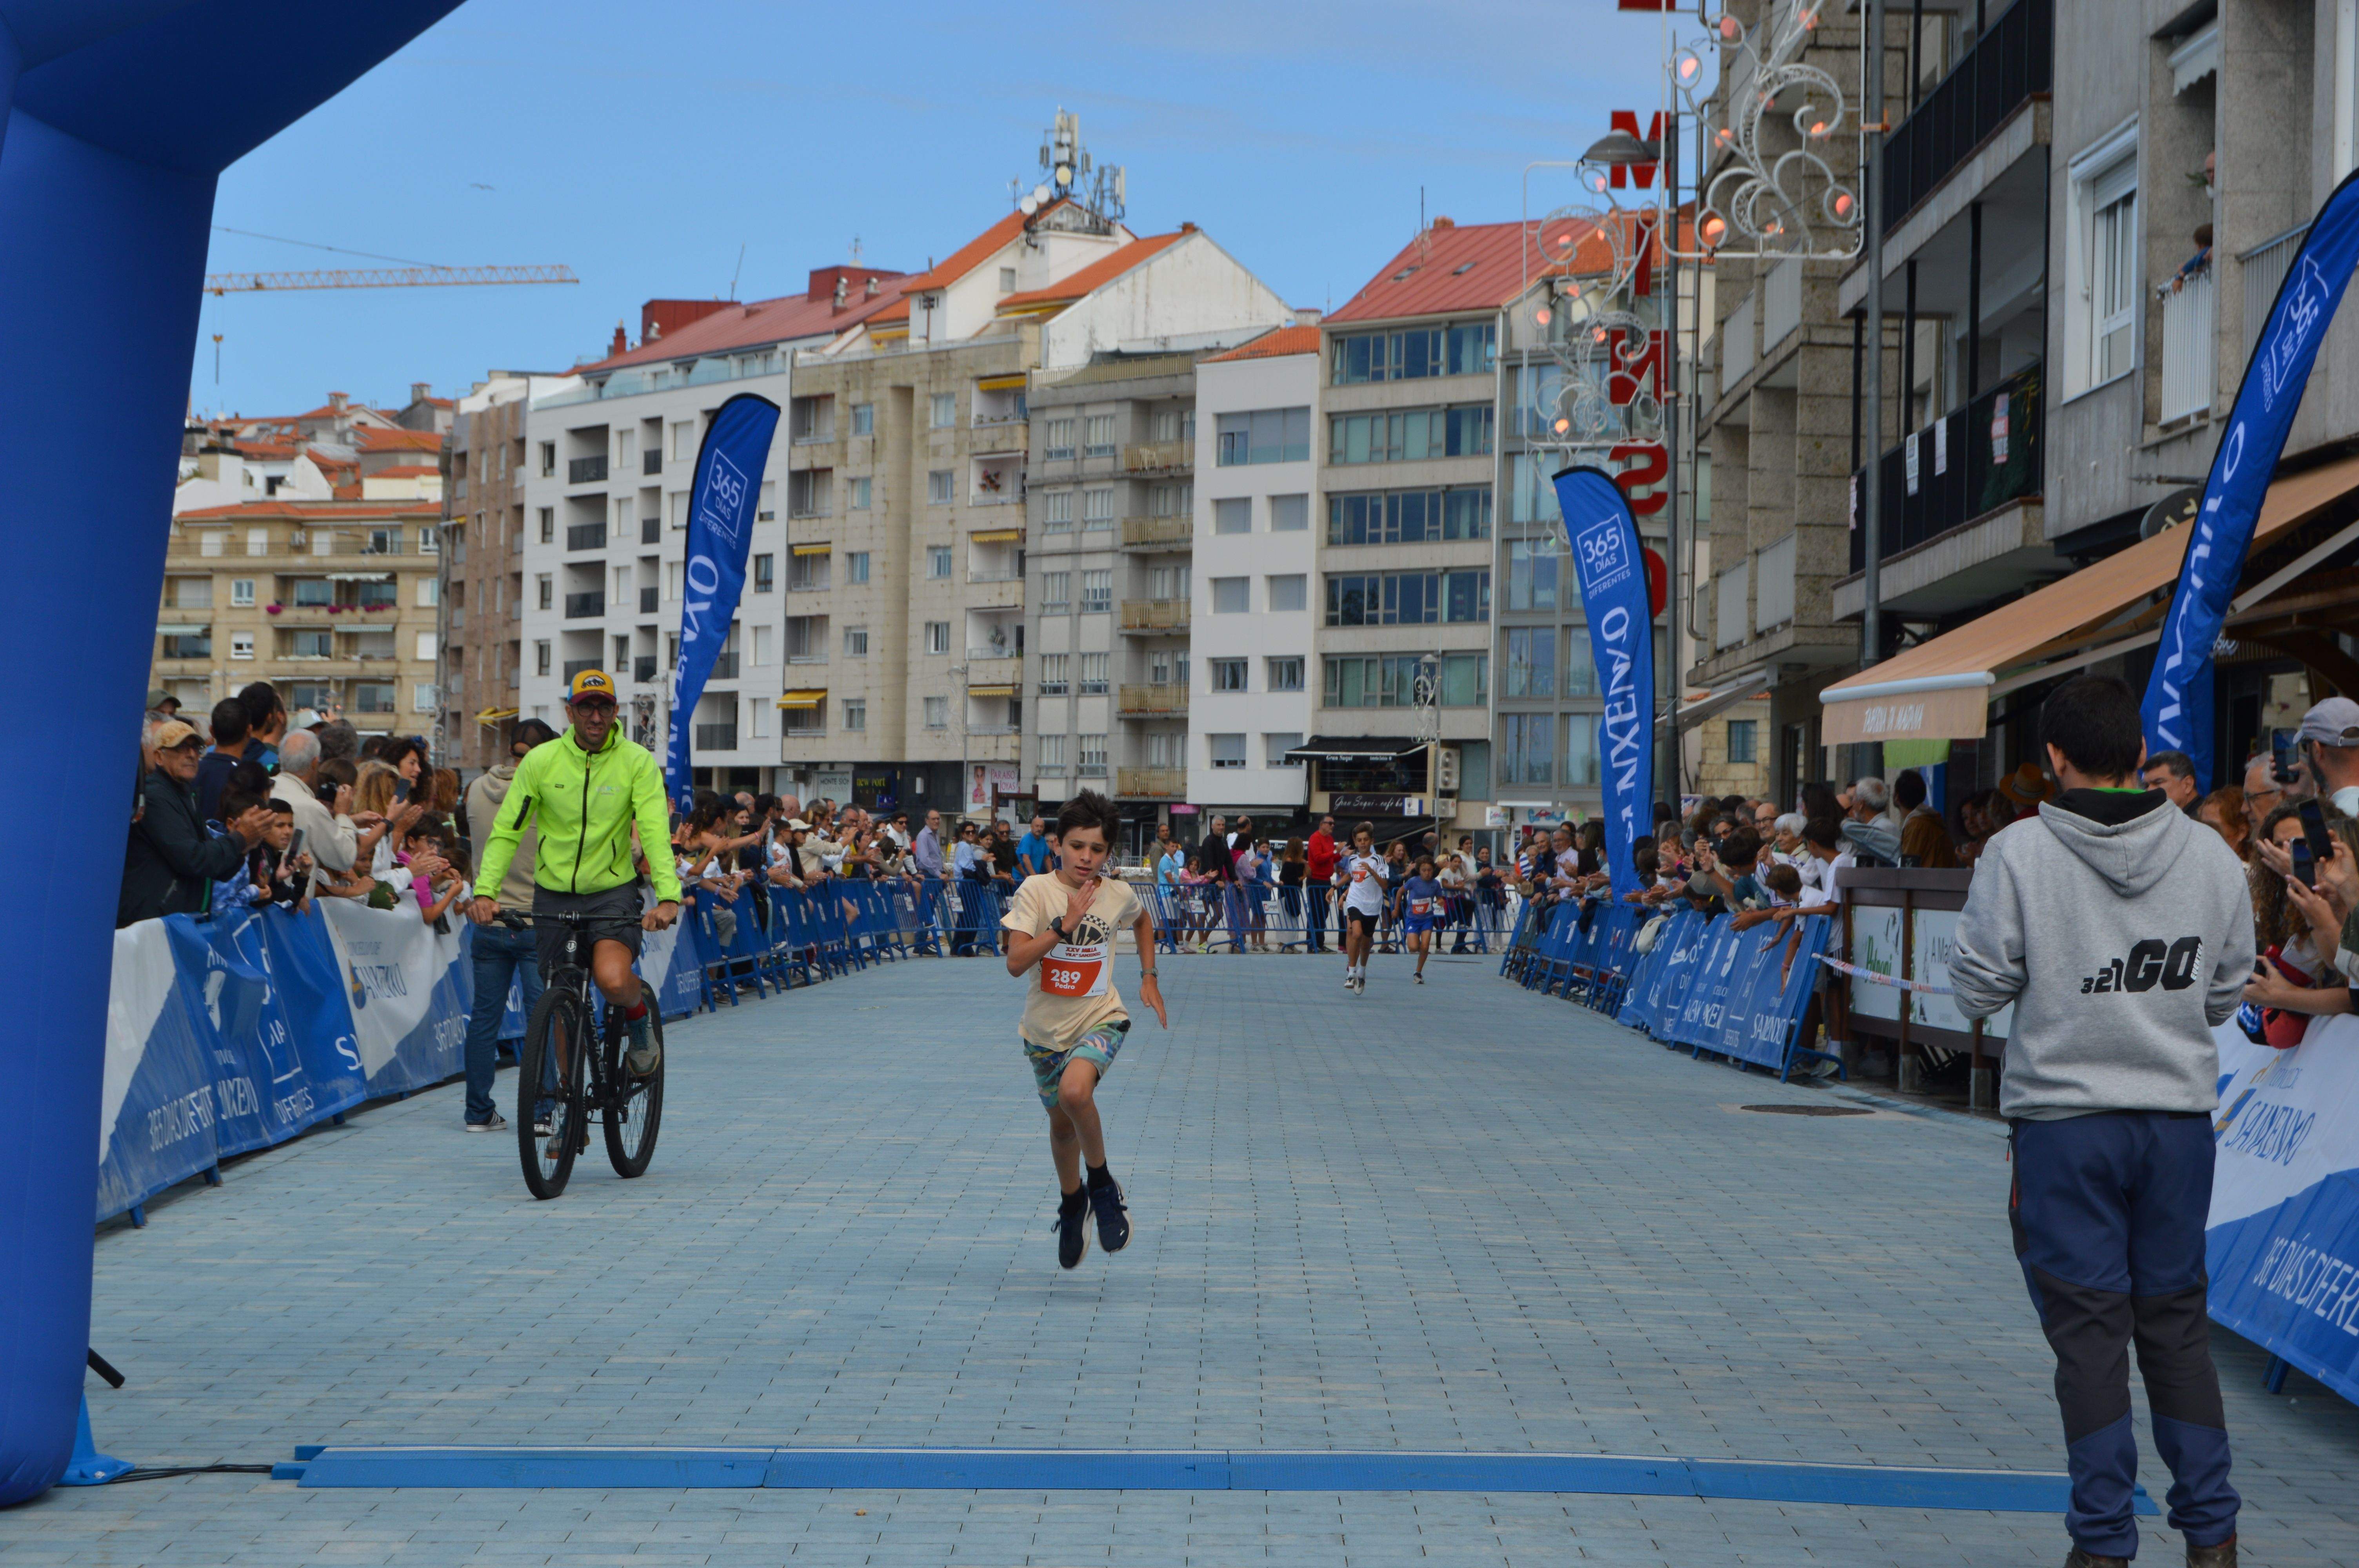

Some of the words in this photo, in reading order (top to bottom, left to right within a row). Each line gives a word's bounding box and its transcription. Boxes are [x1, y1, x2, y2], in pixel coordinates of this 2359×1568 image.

[711, 464, 741, 508] 365
[1583, 527, 1619, 563] 365
[1595, 553, 1617, 573] DÍAS
[1589, 569, 1631, 600] DIFERENTES
[1334, 795, 1351, 810] Gran
[1353, 795, 1374, 809] Suqui
[1050, 969, 1081, 984] 289
[2267, 1232, 2317, 1301] DÍAS
